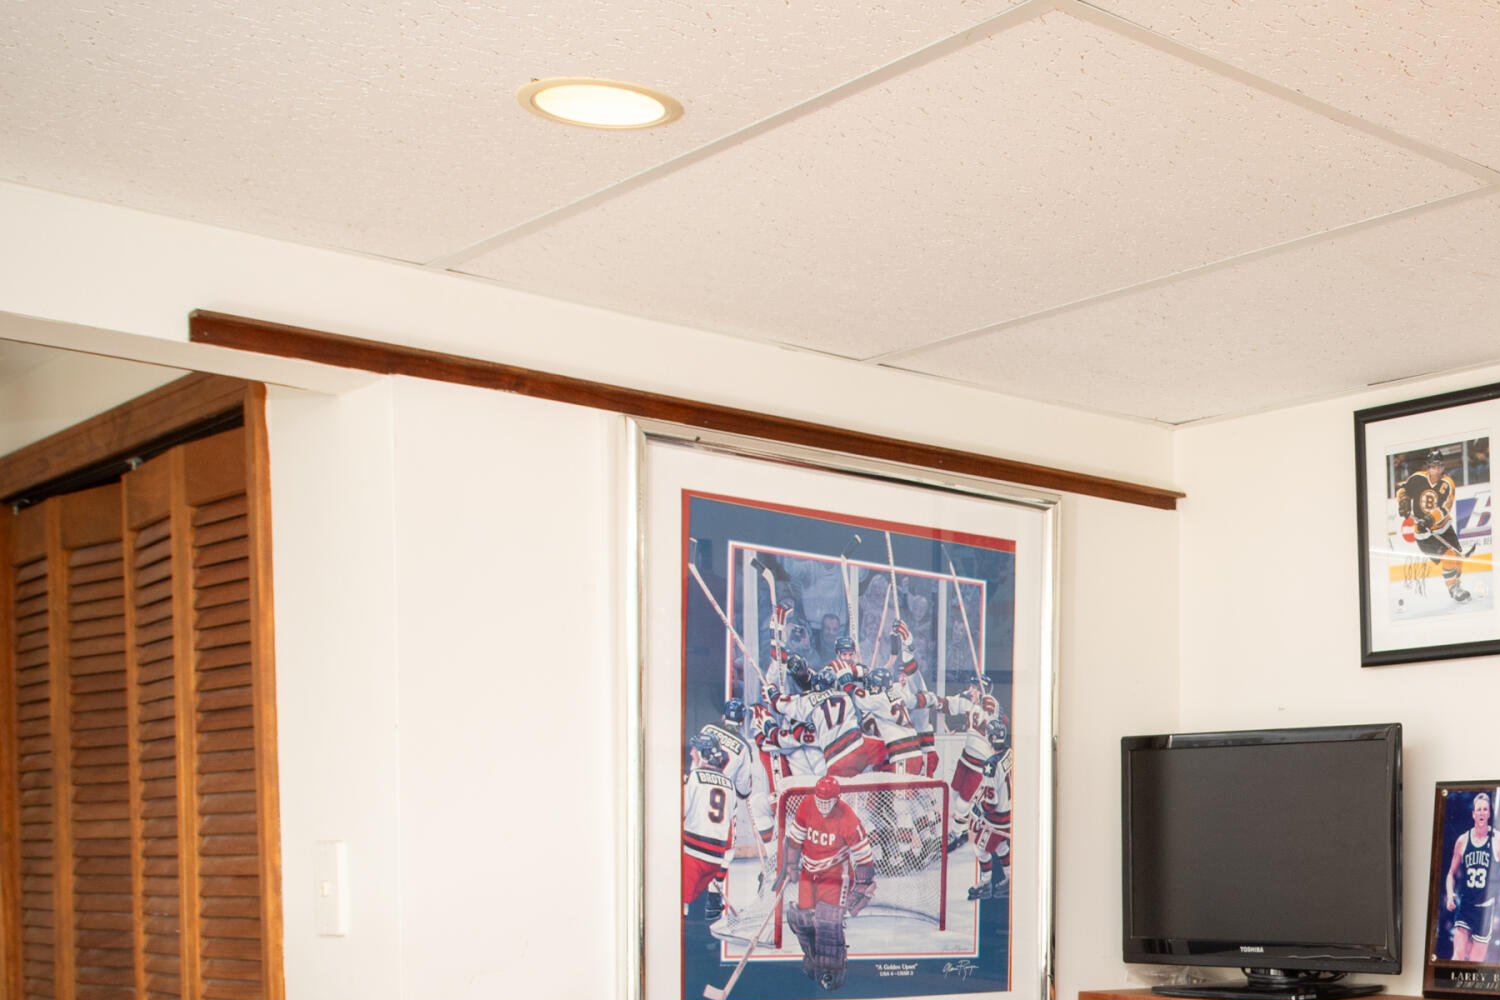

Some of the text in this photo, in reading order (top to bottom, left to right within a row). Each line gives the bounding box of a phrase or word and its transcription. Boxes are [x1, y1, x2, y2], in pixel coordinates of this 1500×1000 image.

[821, 697, 846, 730] 17
[708, 788, 726, 824] 9
[807, 827, 836, 846] CCCP
[1465, 851, 1490, 868] CELTICS
[1466, 868, 1487, 889] 33
[1451, 971, 1486, 981] LARRY
